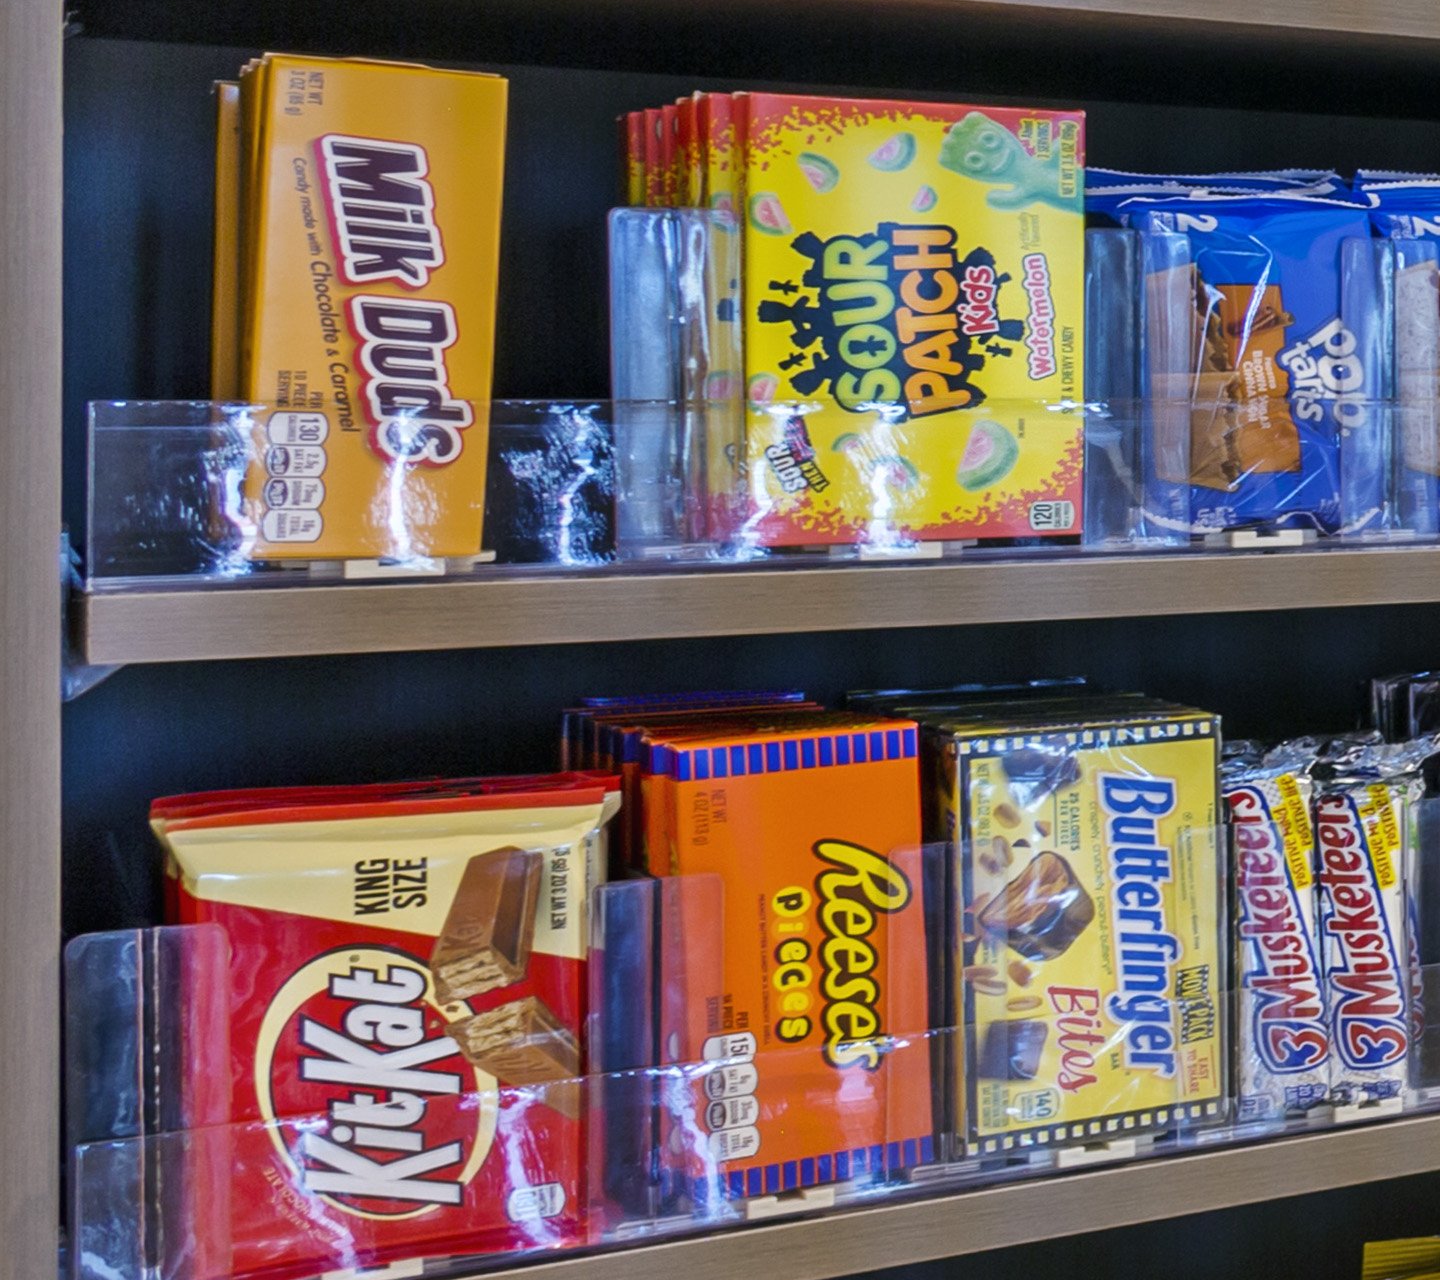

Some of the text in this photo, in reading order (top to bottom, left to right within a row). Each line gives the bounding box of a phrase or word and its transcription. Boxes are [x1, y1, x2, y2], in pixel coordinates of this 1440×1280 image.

[321, 136, 439, 284] Milk
[822, 239, 901, 413] SOUR
[895, 225, 978, 417] PATCH
[963, 266, 997, 335] Kids
[1023, 253, 1056, 380] Watermelon
[348, 296, 470, 466] Duds
[353, 858, 390, 916] KING
[392, 857, 428, 908] SIZE
[1099, 774, 1181, 1078] Butterfinger
[773, 885, 812, 1043] pieces
[1047, 986, 1105, 1094] Bites
